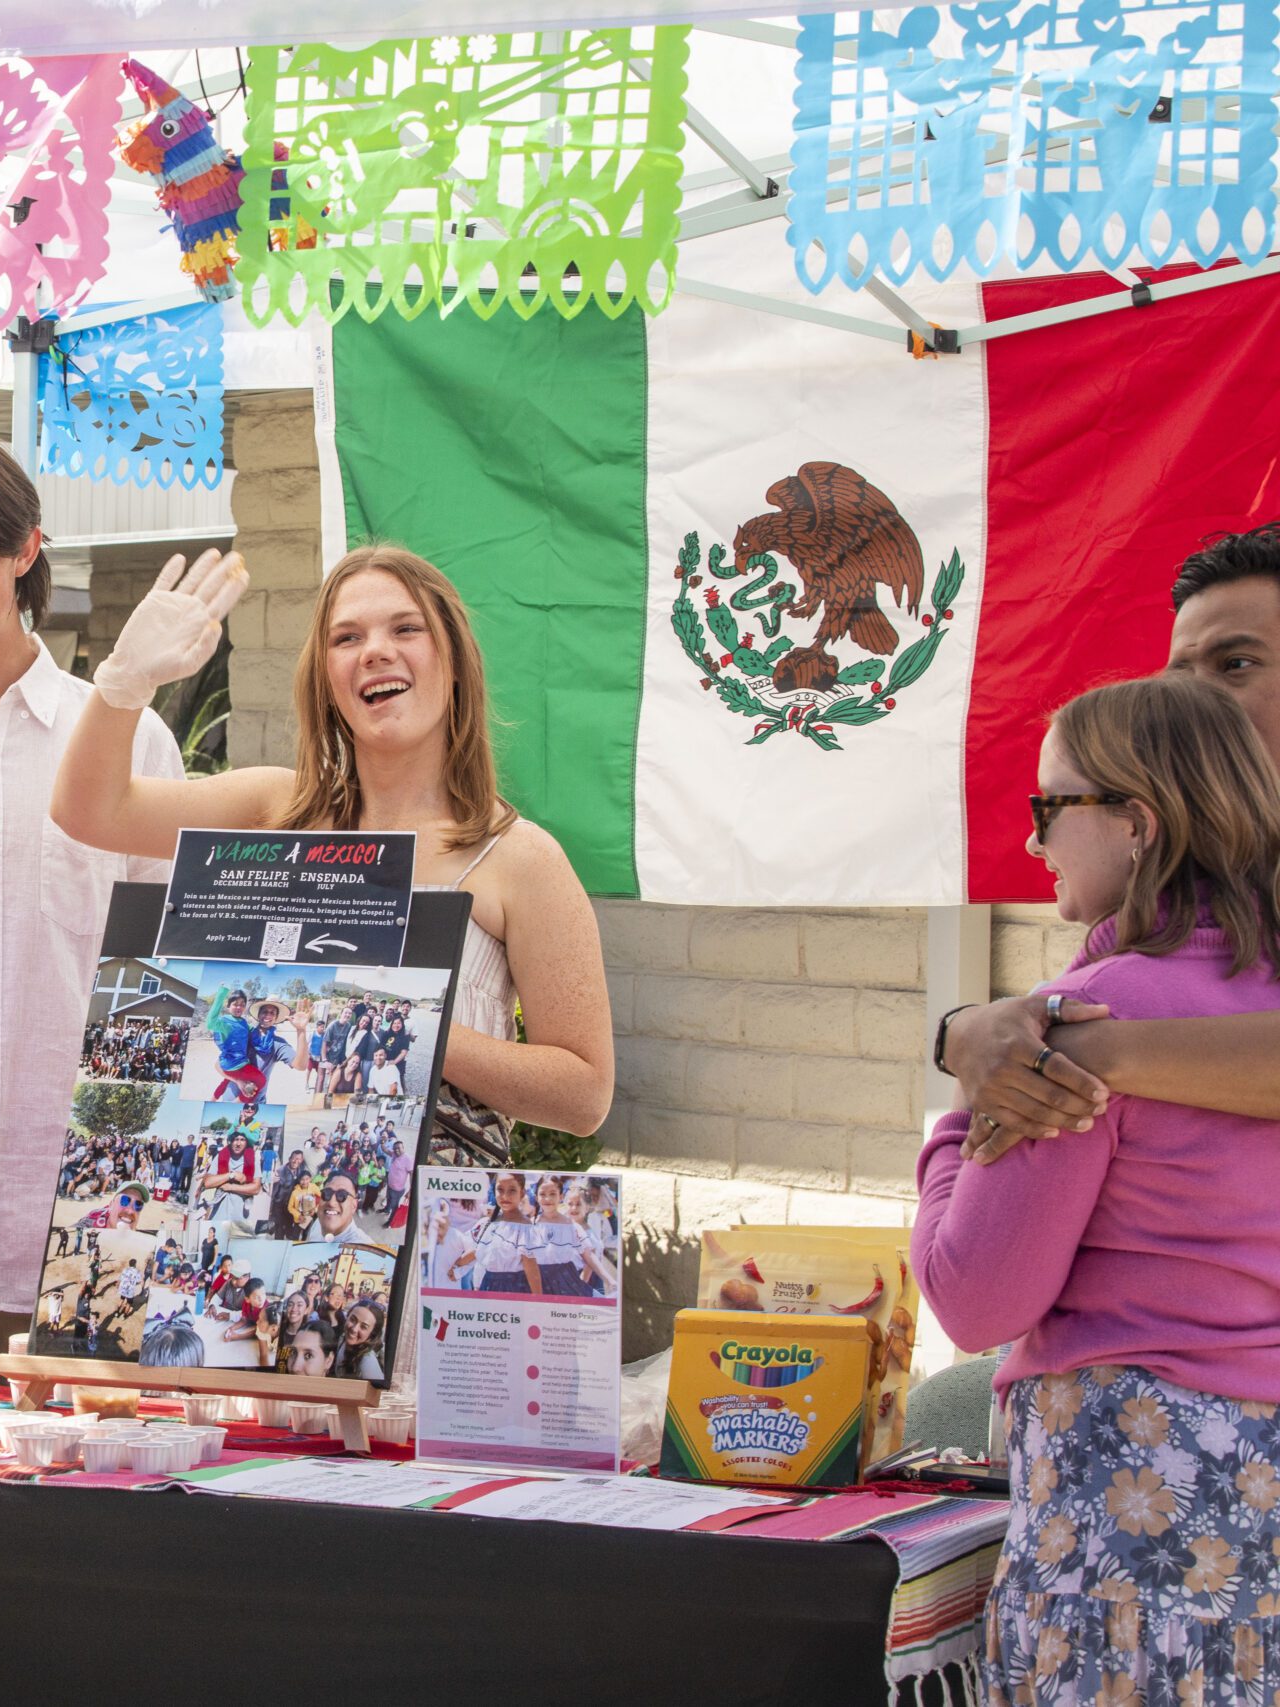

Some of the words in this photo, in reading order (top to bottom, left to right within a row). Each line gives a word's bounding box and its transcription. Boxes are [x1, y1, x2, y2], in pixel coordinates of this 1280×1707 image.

[284, 842, 301, 864] A
[220, 870, 245, 879] SAN
[248, 870, 290, 881] FELIPE
[300, 872, 365, 884] ENSENADA
[183, 892, 198, 900] Join
[217, 893, 242, 901] Mexico
[290, 896, 306, 904] with
[321, 897, 351, 905] Mexican
[352, 898, 382, 906] brothers
[217, 902, 232, 910] both
[261, 904, 276, 912] Baja
[277, 905, 315, 914] California,
[317, 907, 347, 916] bringing
[361, 908, 386, 916] Gospel
[286, 916, 322, 924] programs,
[339, 918, 359, 926] youth
[205, 934, 226, 942] Apply
[227, 934, 251, 943] Today!
[426, 1178, 482, 1192] Mexico
[772, 1289, 805, 1299] Fruity
[447, 1310, 475, 1321] How
[477, 1311, 508, 1323] EFCC
[509, 1313, 521, 1324] is
[550, 1310, 568, 1319] How
[457, 1327, 511, 1340] involved:
[721, 1341, 813, 1367] Crayola
[702, 1395, 739, 1405] Washability
[716, 1431, 801, 1455] MARKERS
[722, 1456, 761, 1467] ASSORTED
[763, 1457, 793, 1471] COLORS
